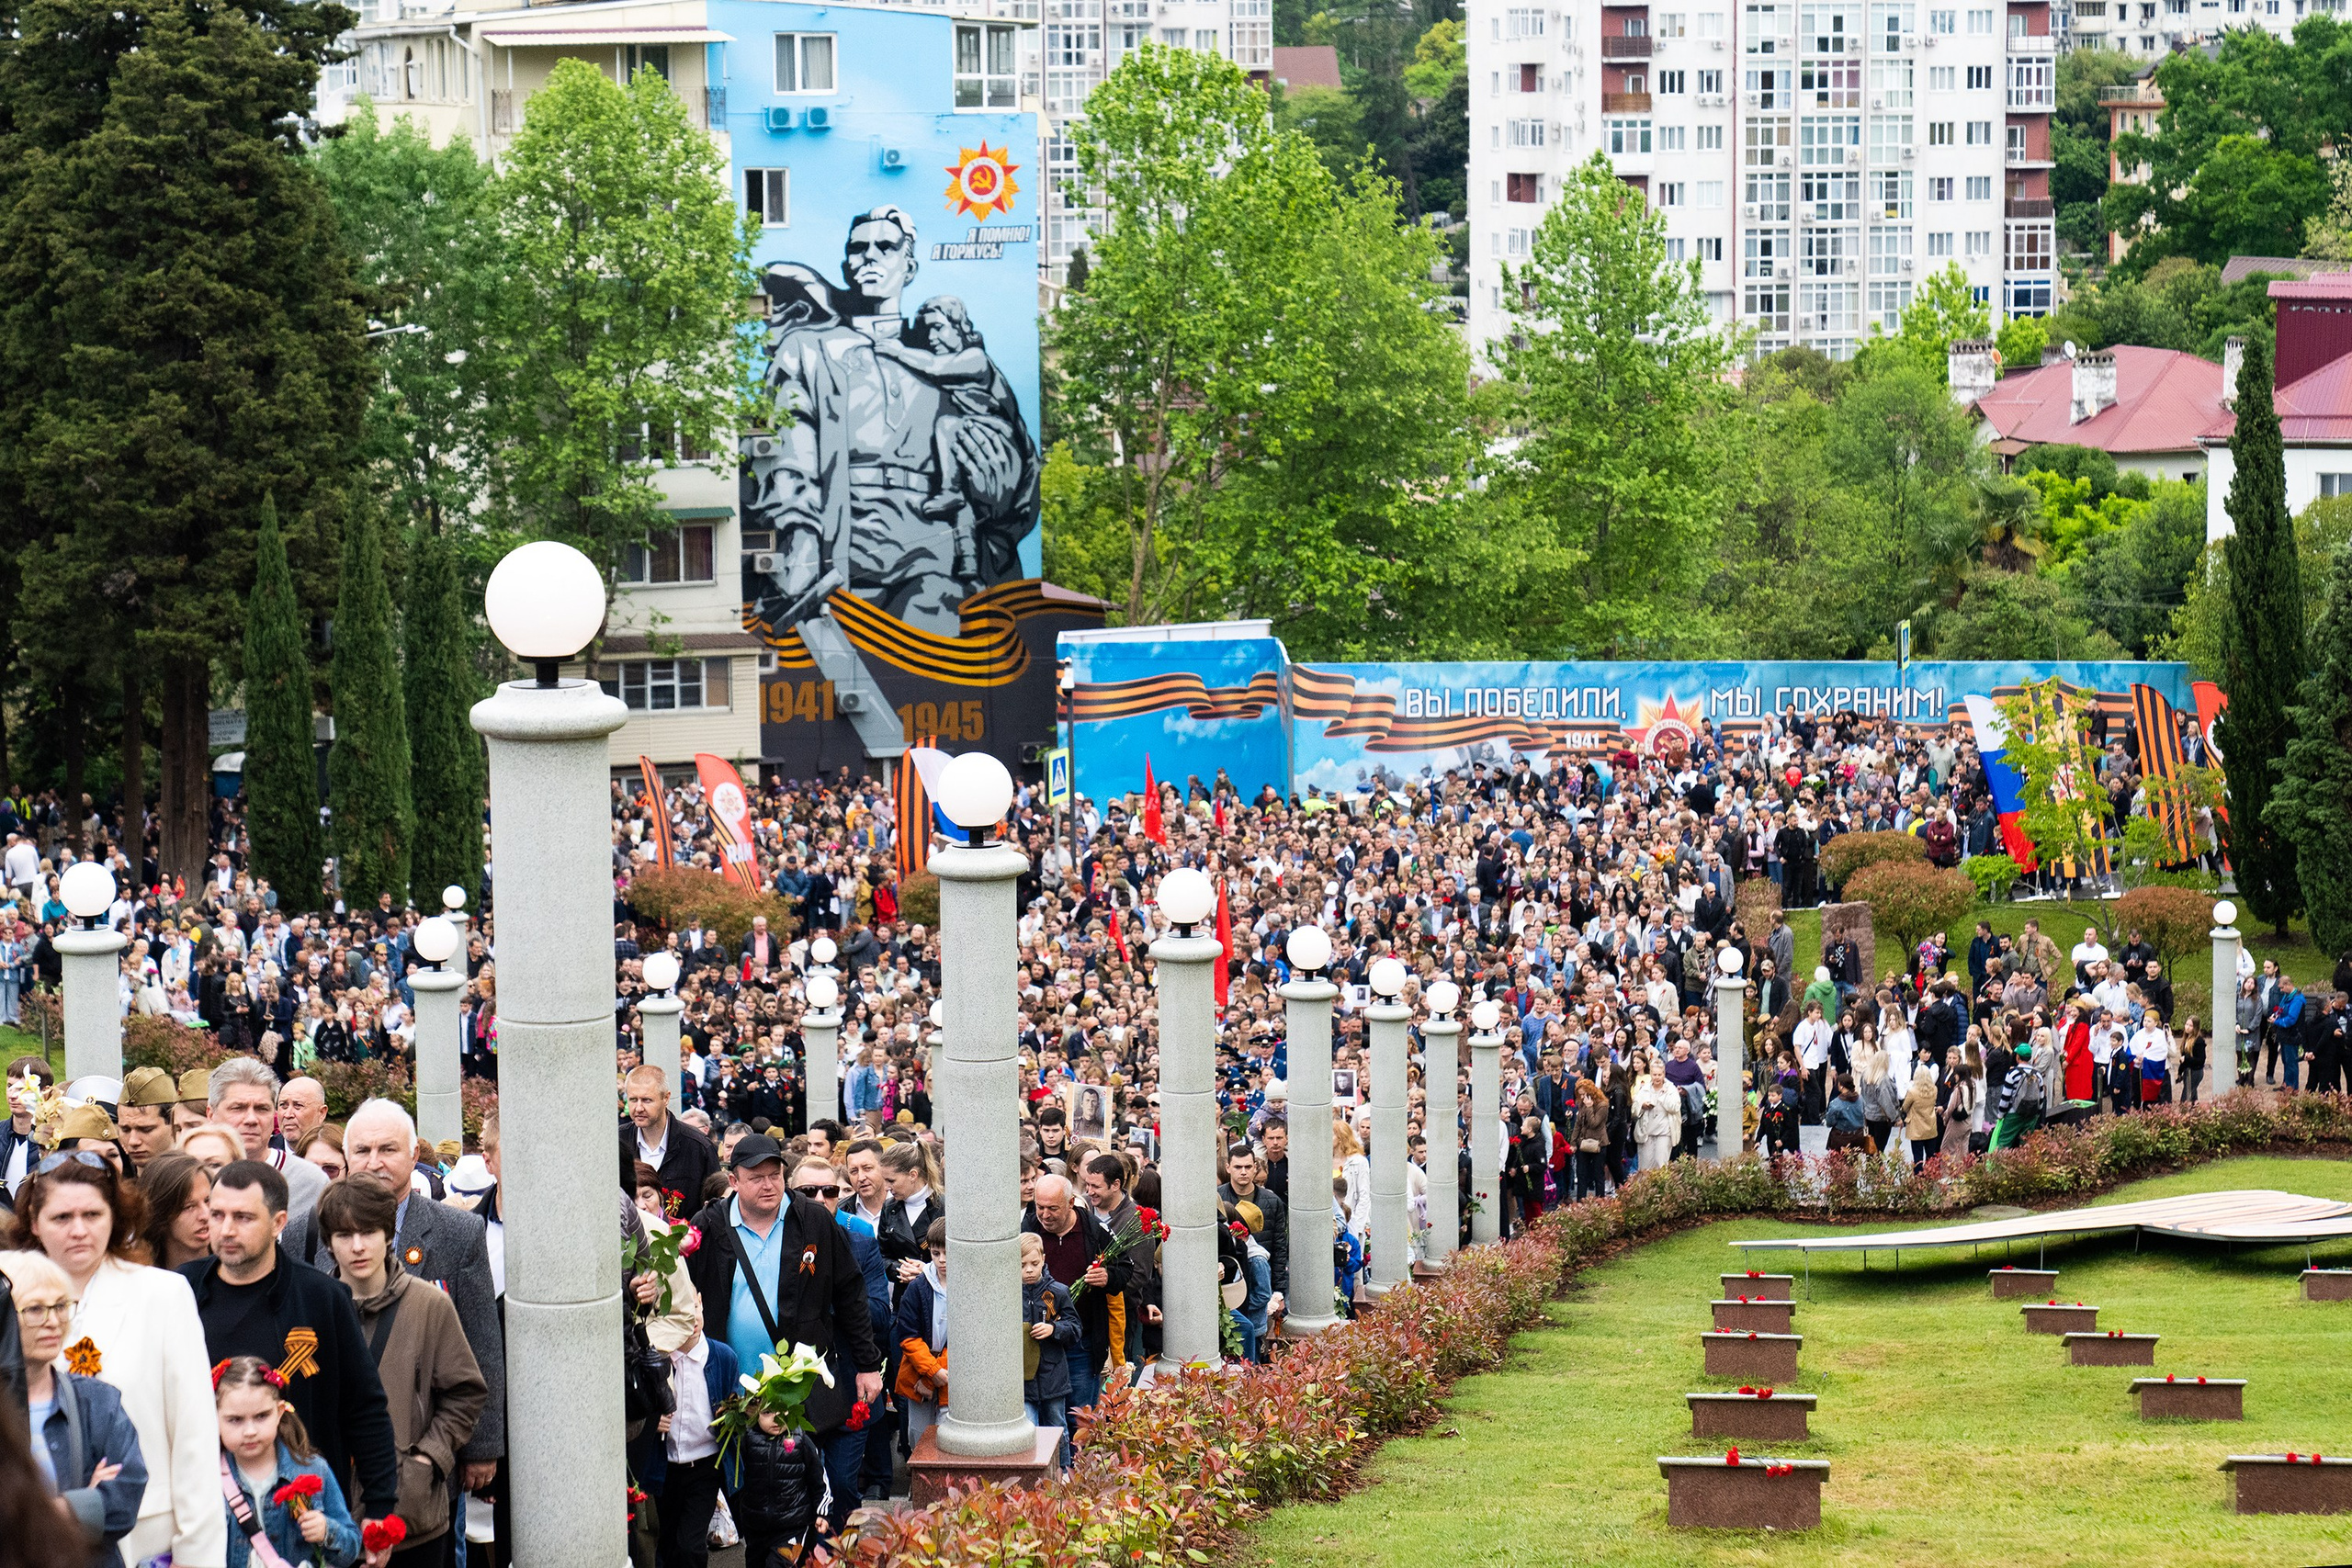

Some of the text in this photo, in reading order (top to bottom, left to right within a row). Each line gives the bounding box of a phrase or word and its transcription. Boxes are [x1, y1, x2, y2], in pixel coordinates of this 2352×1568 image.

[967, 225, 1031, 243] Я ПОМНЮ!
[931, 243, 1003, 260] Я ГОРЖУСЬ!
[760, 680, 834, 724] 1941
[1405, 686, 1628, 719] ВЫ ПОБЕДИЛИ,
[1711, 686, 1943, 717] МЫ СОХРАНИМ!
[897, 700, 985, 742] 1945
[1564, 732, 1600, 749] 1941
